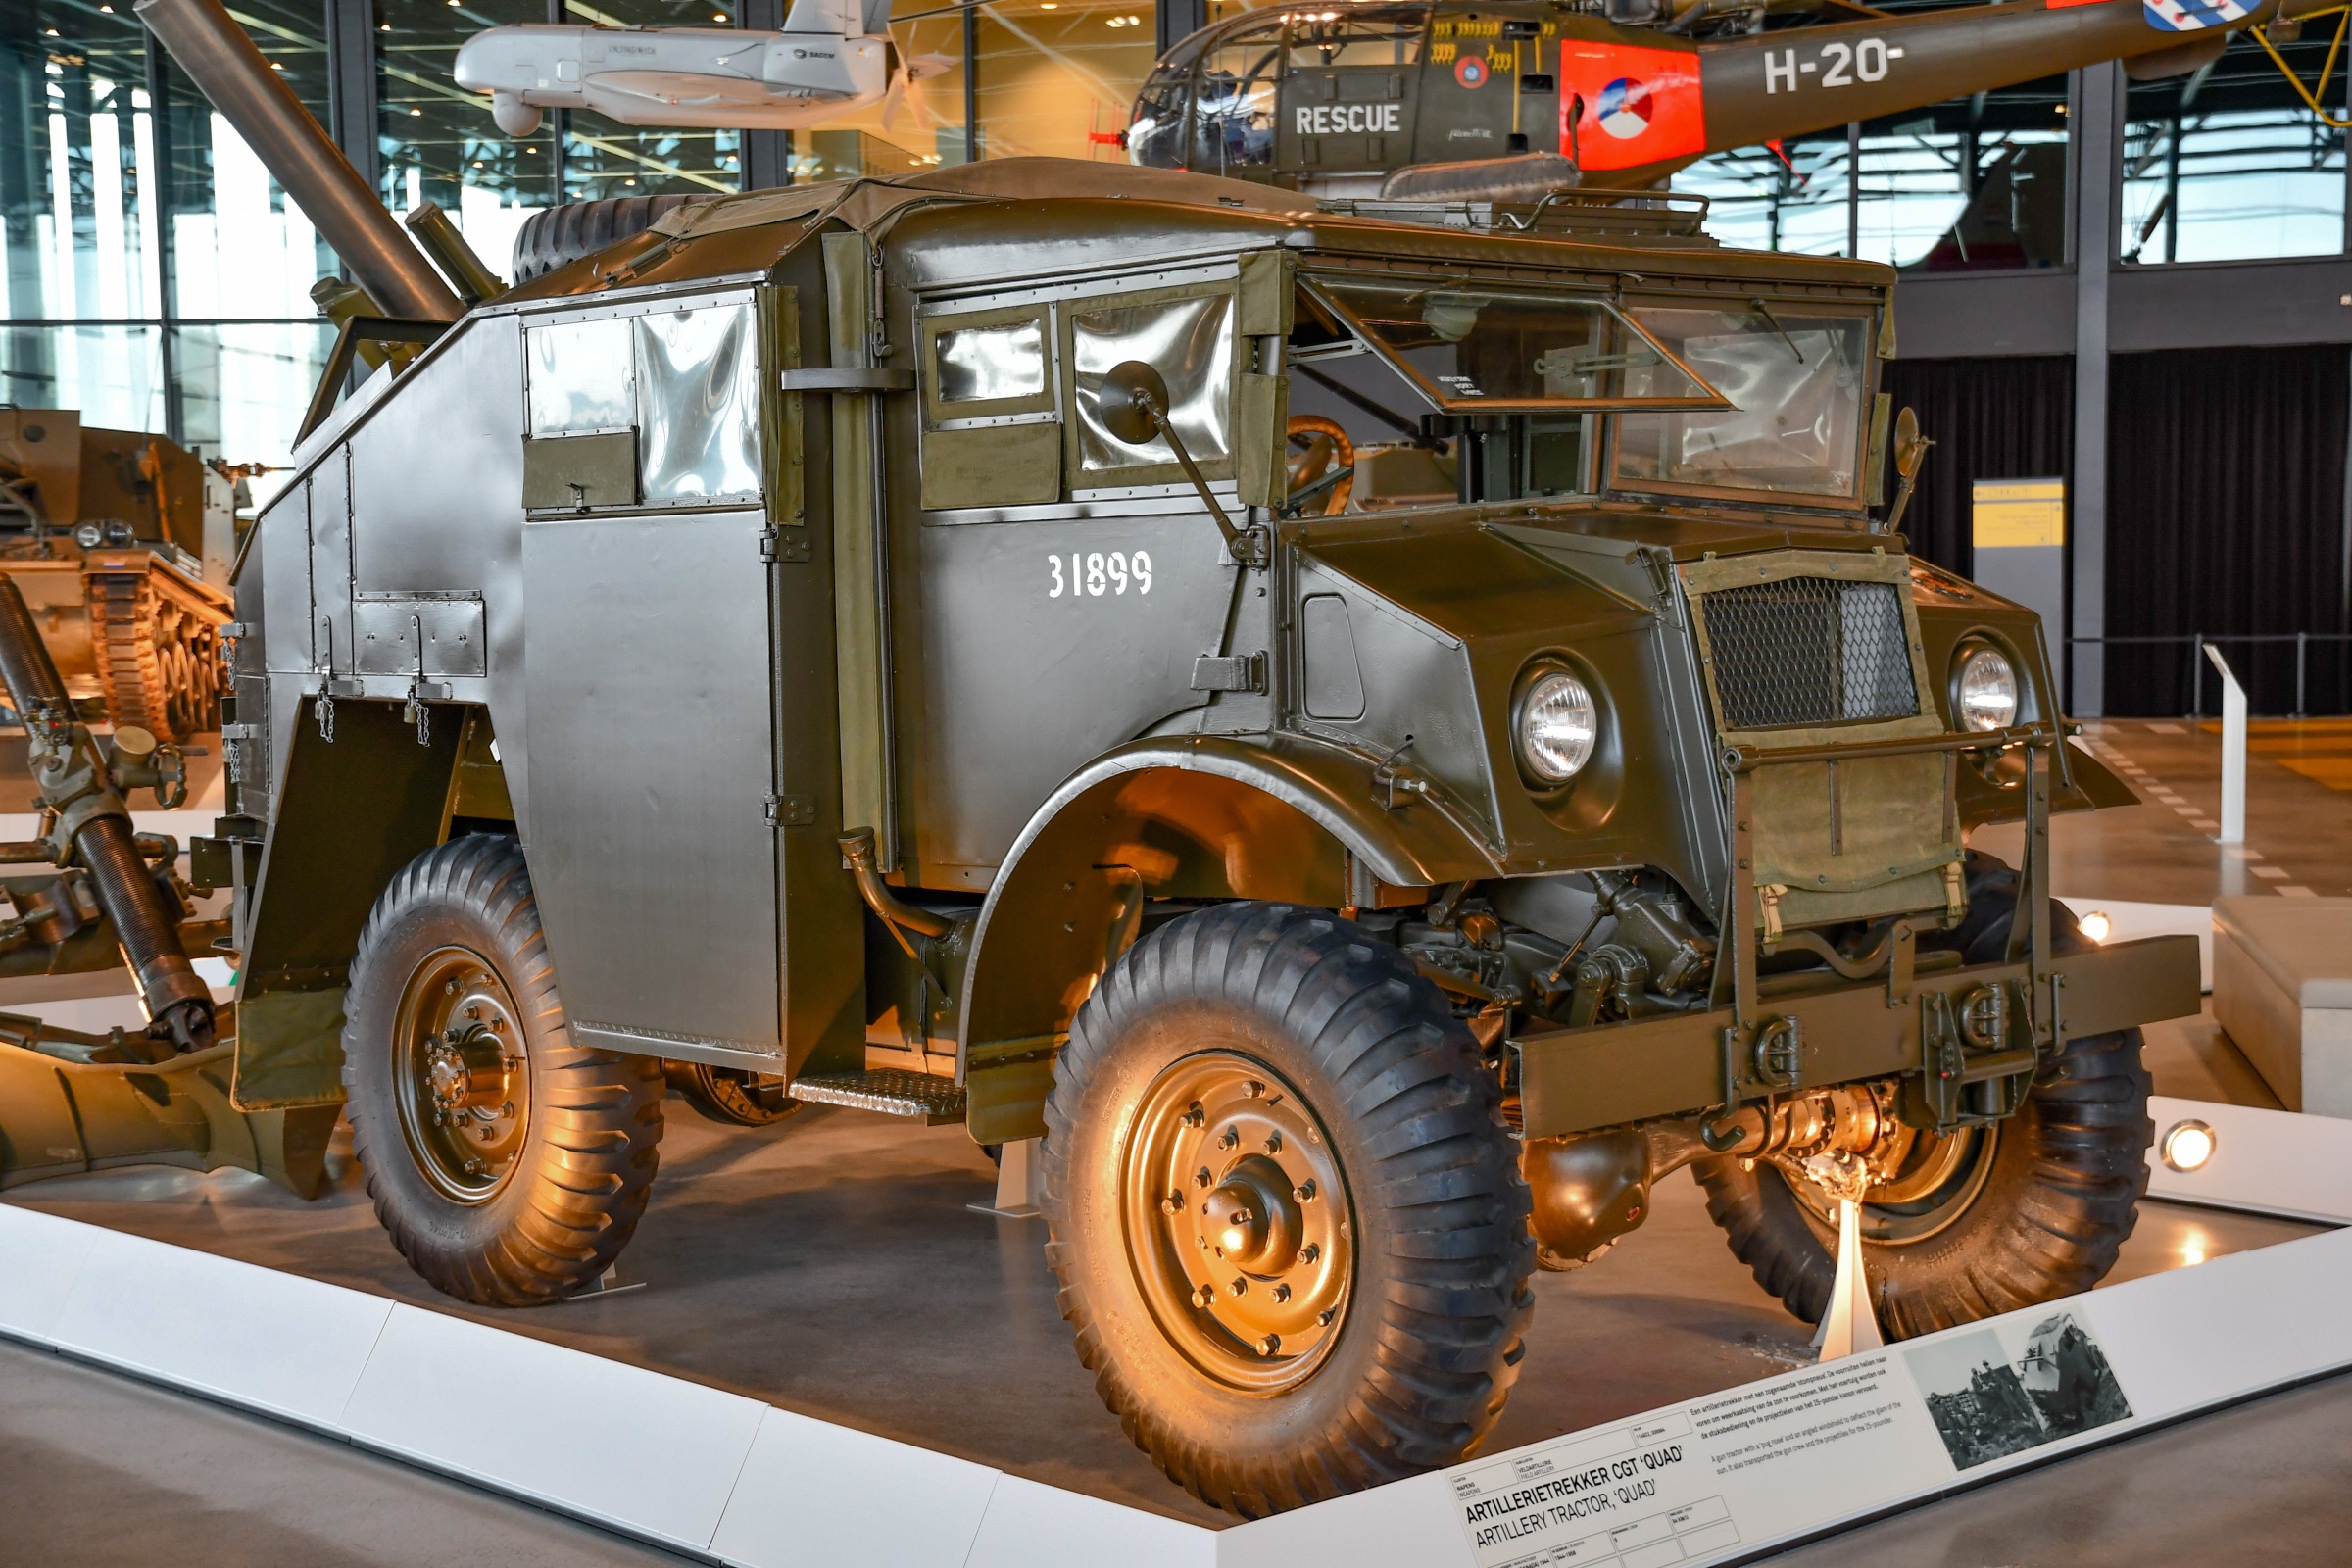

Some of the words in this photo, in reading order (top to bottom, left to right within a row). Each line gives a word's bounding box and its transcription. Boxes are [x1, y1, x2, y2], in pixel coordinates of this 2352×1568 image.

[1296, 104, 1401, 134] RESCUE
[1047, 550, 1152, 598] 31899
[1518, 1459, 1552, 1473] VELDARTILLERIE
[1533, 1466, 1555, 1476] ARTILLERY
[1457, 1481, 1475, 1491] WAPENS
[1459, 1487, 1480, 1498] WEAPONS
[1466, 1467, 1611, 1524] ARTILLERIETREKKER
[1612, 1458, 1639, 1479] CGT
[1476, 1511, 1547, 1549] ARTILLERY
[1547, 1493, 1617, 1525] TRACTOR,
